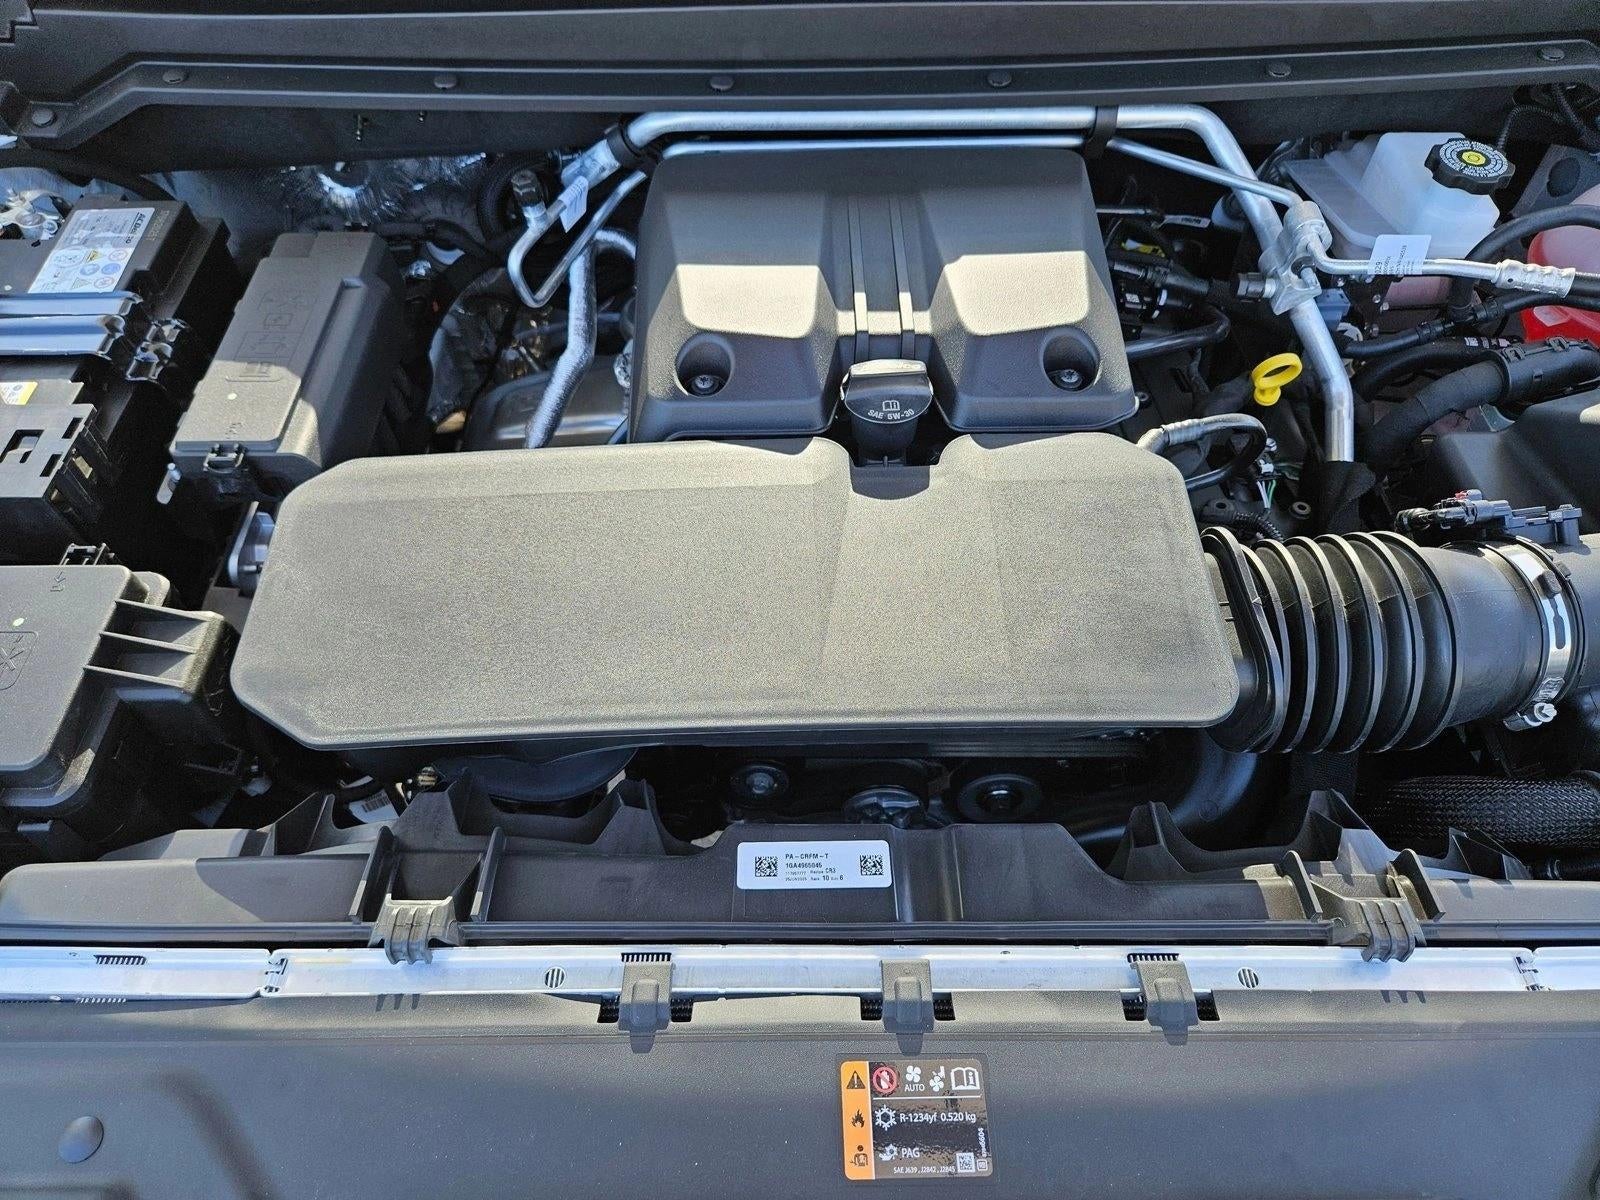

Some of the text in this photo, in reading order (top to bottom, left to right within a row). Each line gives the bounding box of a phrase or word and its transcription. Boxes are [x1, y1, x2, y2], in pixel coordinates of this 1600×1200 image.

[868, 408, 915, 420] SAE 5W-30
[904, 1083, 925, 1092] AUTO
[899, 1111, 976, 1124] R-1234yf 0.520 kg
[901, 1148, 920, 1158] PAG
[893, 1166, 904, 1174] SAE
